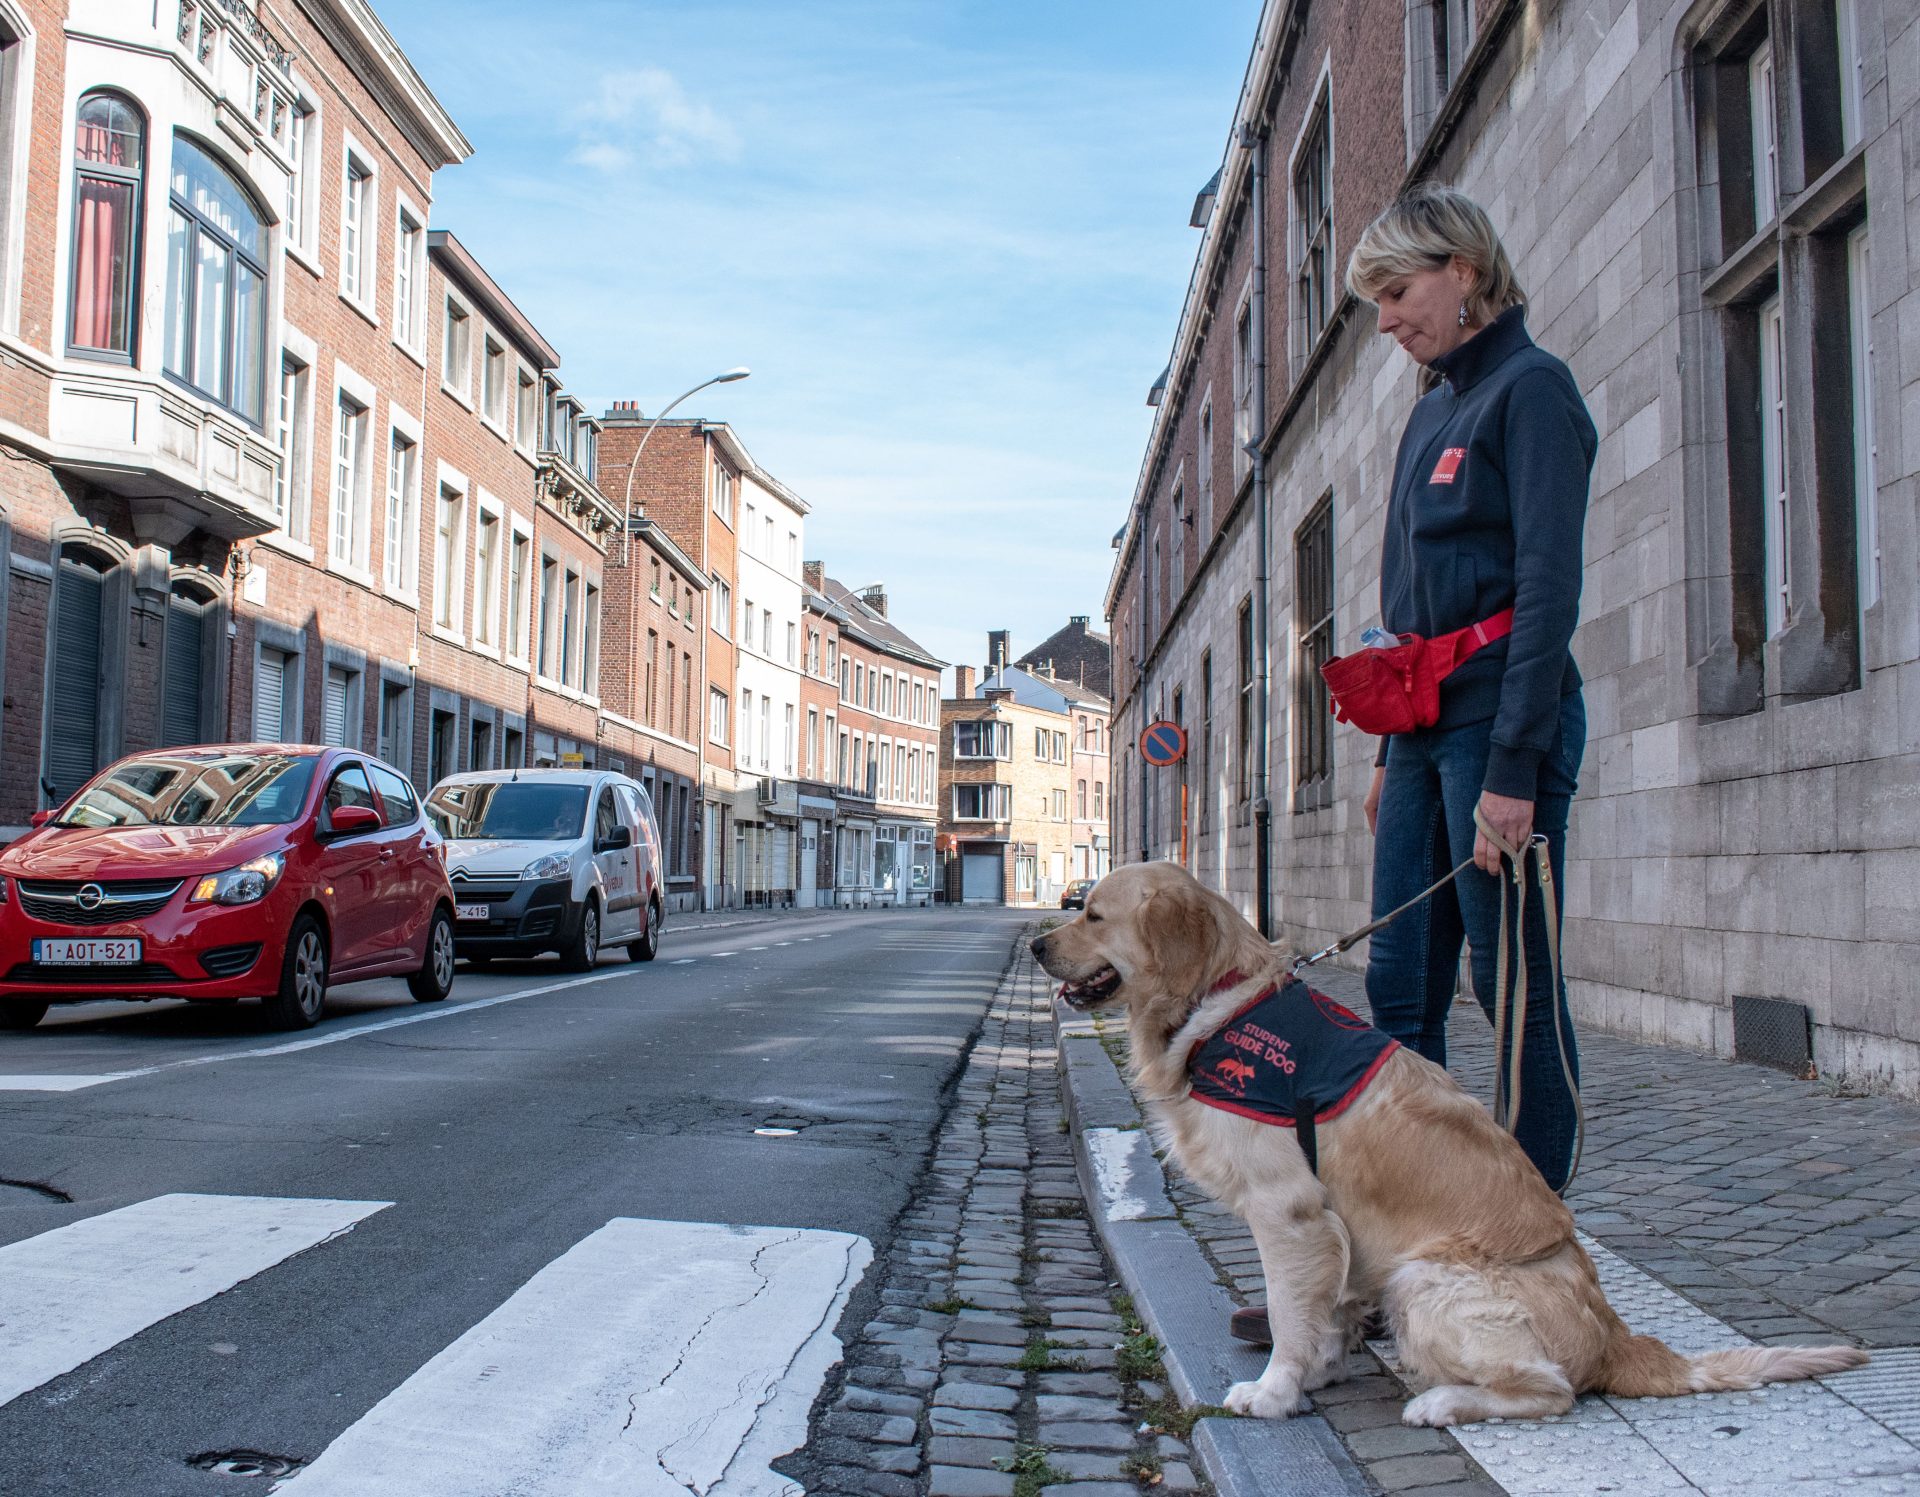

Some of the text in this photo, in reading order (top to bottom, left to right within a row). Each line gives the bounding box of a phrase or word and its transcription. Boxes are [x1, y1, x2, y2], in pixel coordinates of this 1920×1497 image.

[34, 952, 41, 961] B
[46, 943, 136, 960] 1-AOT-521
[1243, 1023, 1292, 1053] STUDENT
[1224, 1030, 1297, 1074] GUIDE DOG
